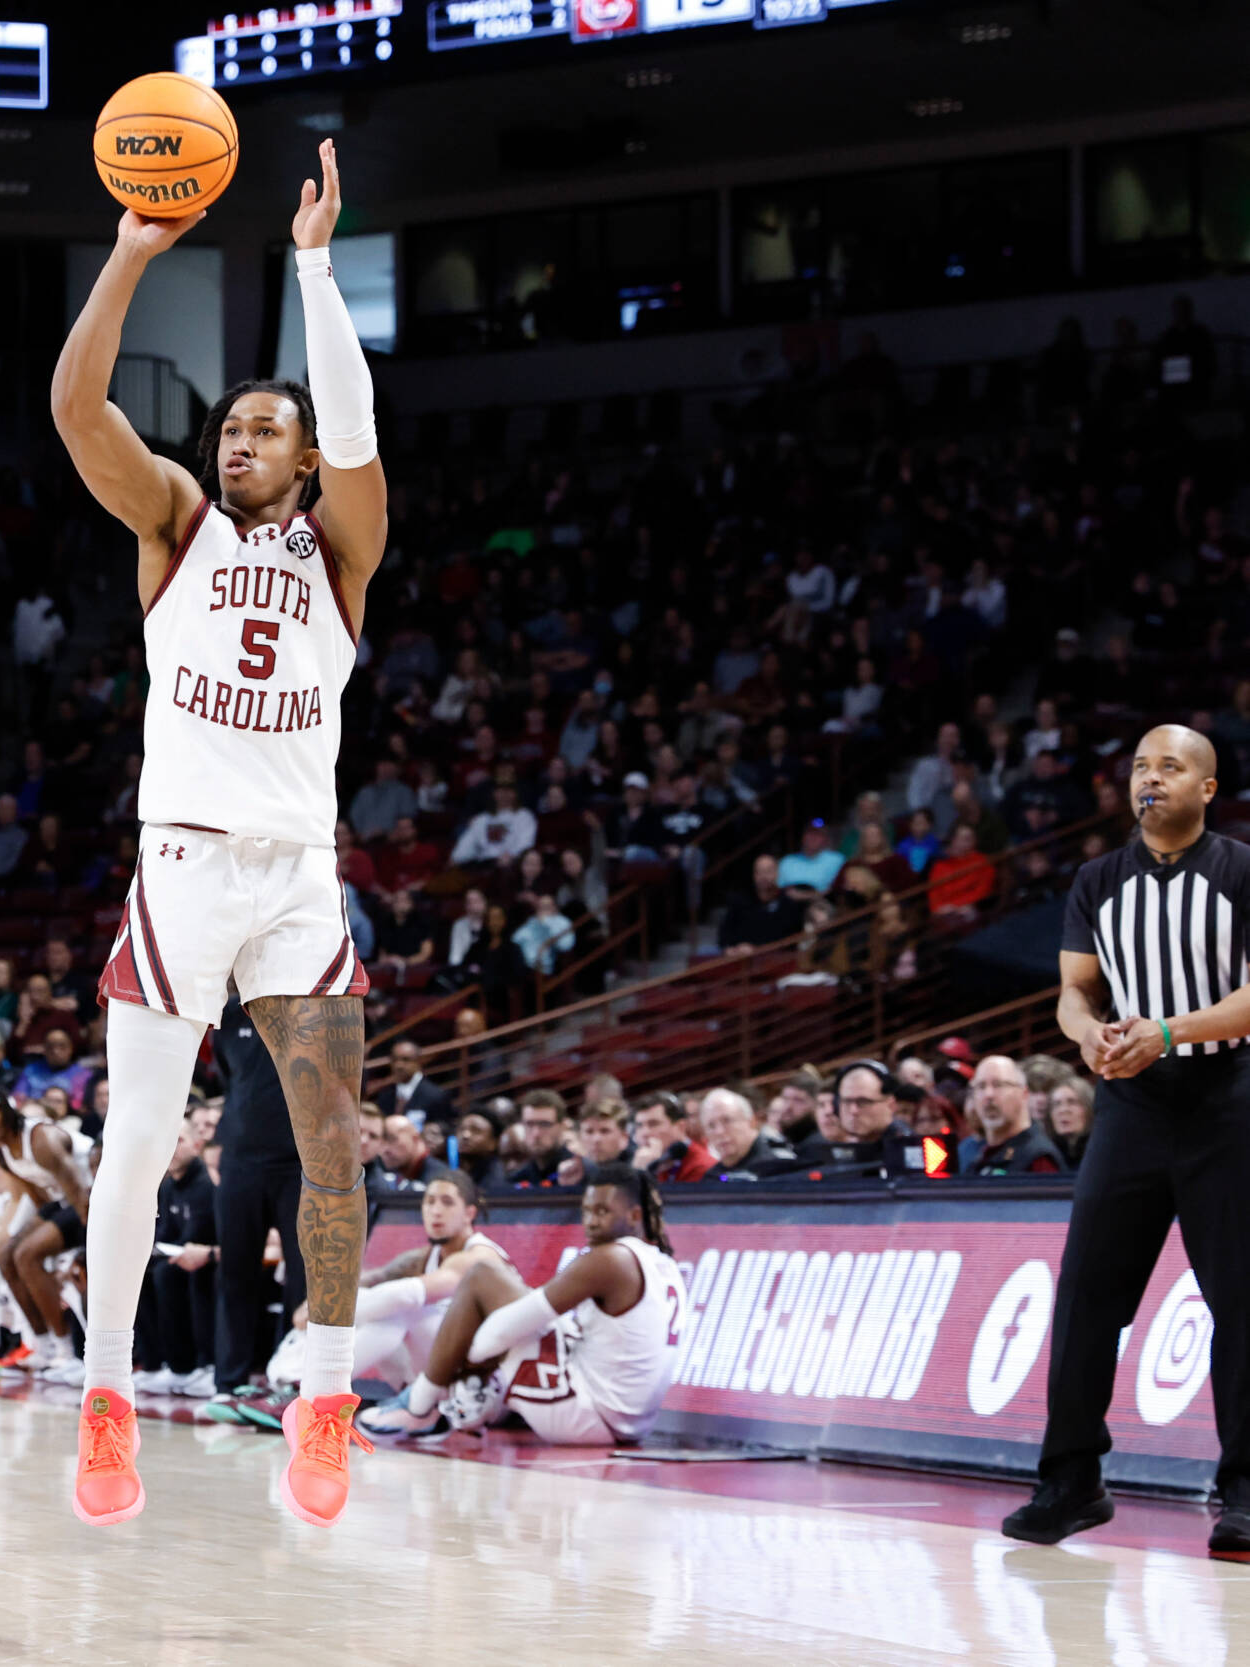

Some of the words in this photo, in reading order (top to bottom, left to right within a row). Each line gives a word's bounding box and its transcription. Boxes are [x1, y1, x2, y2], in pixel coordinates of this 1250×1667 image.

[116, 136, 182, 156] NCAA
[107, 172, 203, 204] Wilson
[289, 532, 315, 558] SEC
[209, 566, 311, 625] SOUTH
[238, 618, 280, 681] 5
[173, 665, 322, 732] CAROLINA
